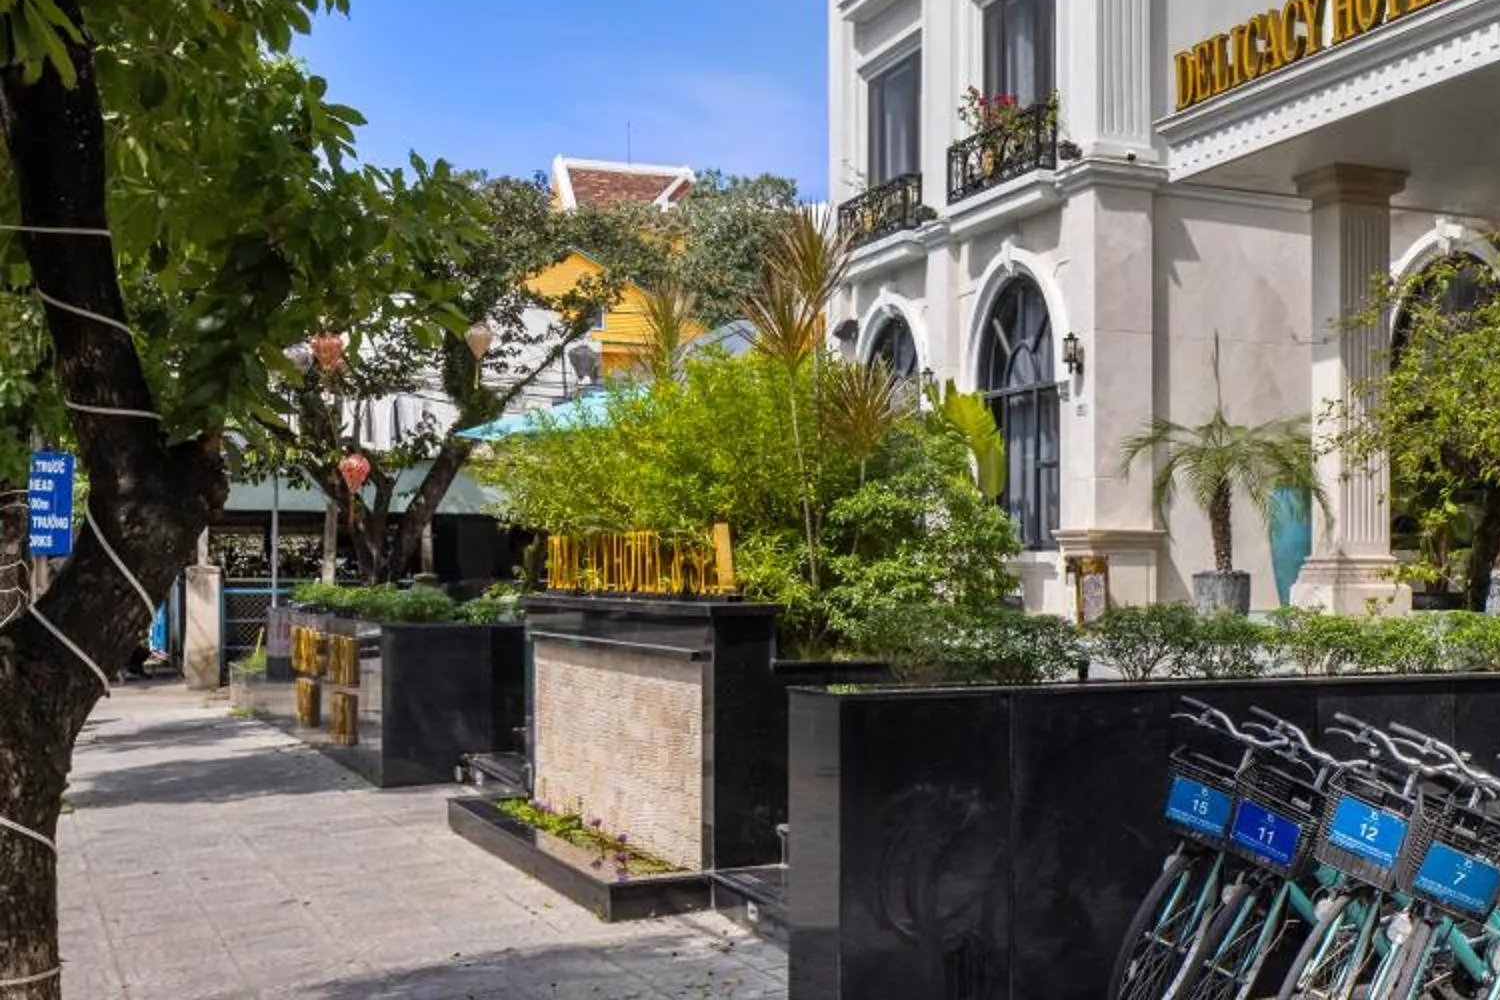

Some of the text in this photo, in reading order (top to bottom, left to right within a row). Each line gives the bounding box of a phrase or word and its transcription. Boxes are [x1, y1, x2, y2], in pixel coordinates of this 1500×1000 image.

[1257, 827, 1275, 844] 11
[1359, 823, 1379, 842] 12
[1453, 872, 1467, 885] 7
